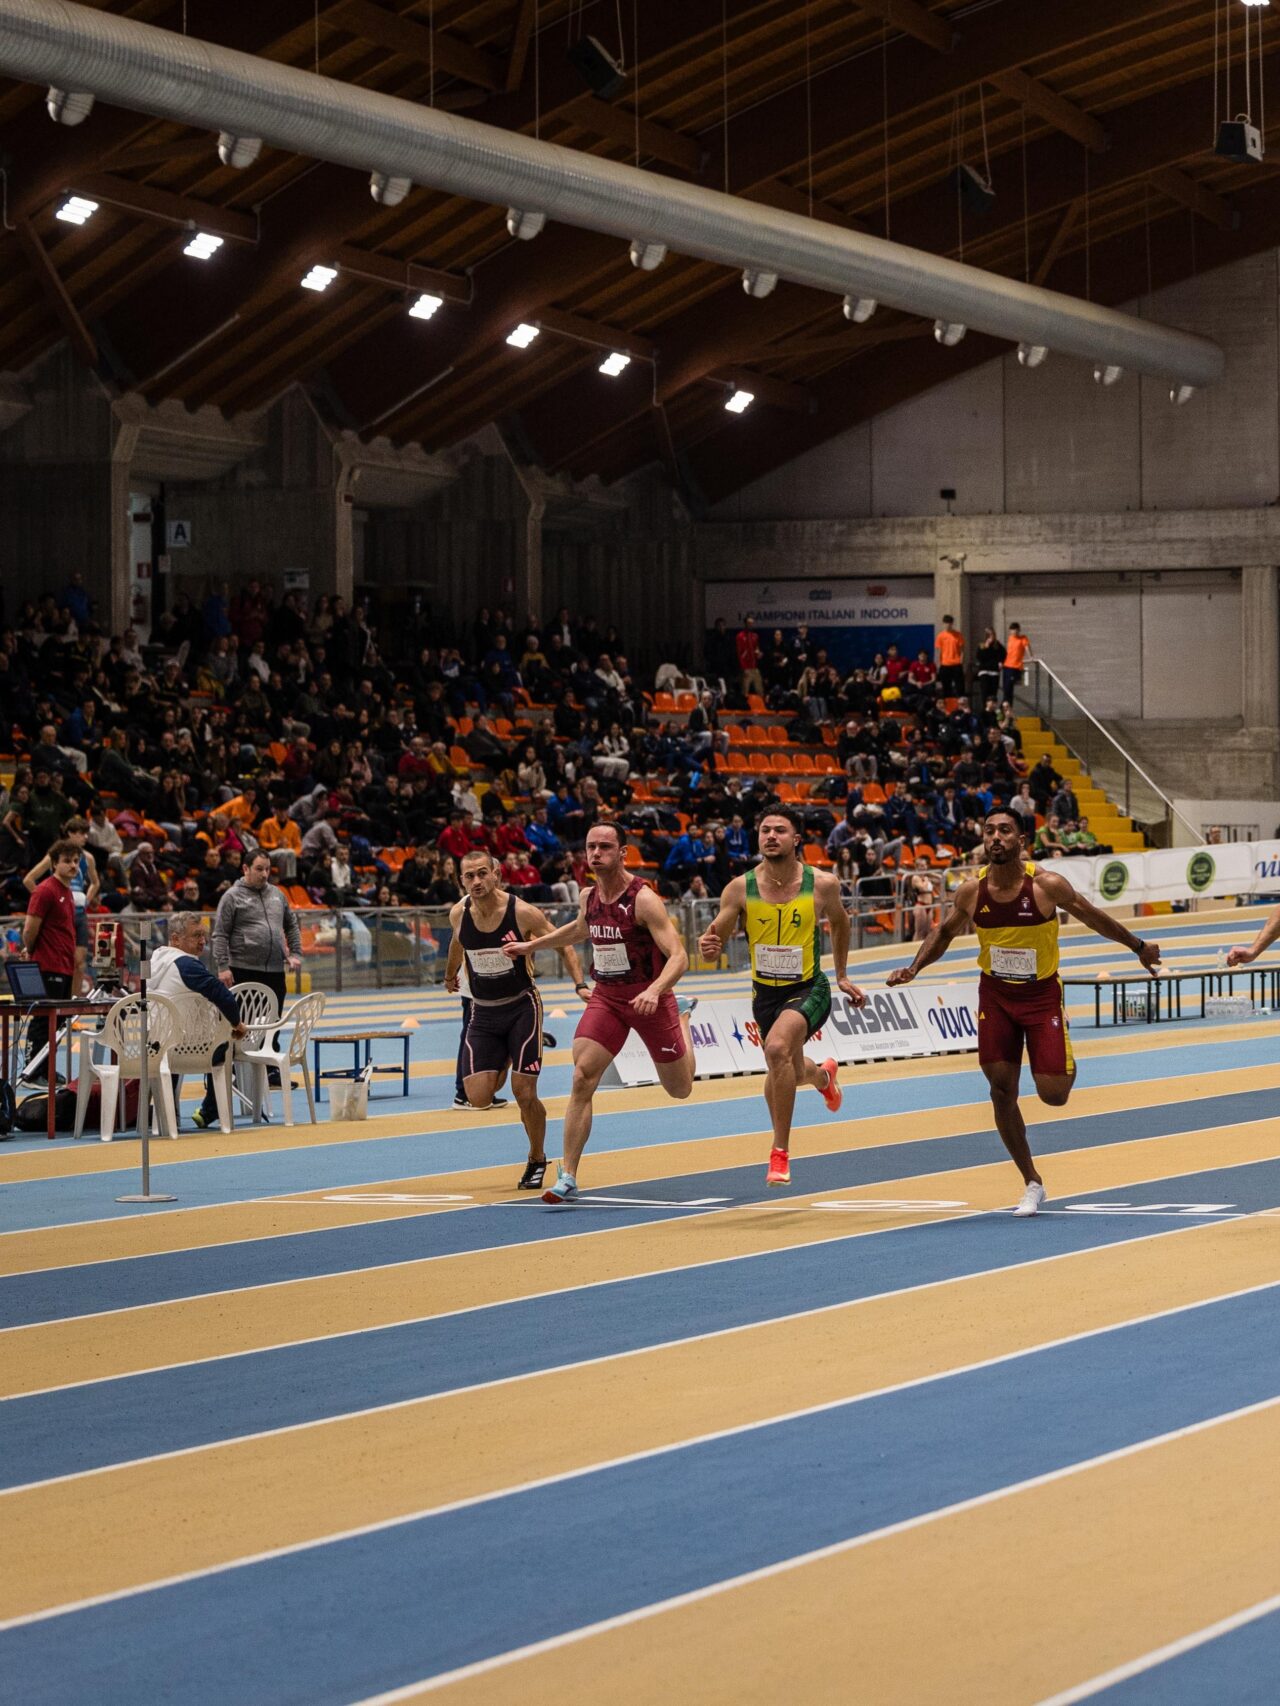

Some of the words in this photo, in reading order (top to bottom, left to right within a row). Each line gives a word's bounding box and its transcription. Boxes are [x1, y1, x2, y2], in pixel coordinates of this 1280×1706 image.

[174, 523, 187, 540] A
[808, 609, 855, 620] ITALIANI
[860, 608, 908, 619] INDOOR
[590, 925, 623, 940] POLIZIA
